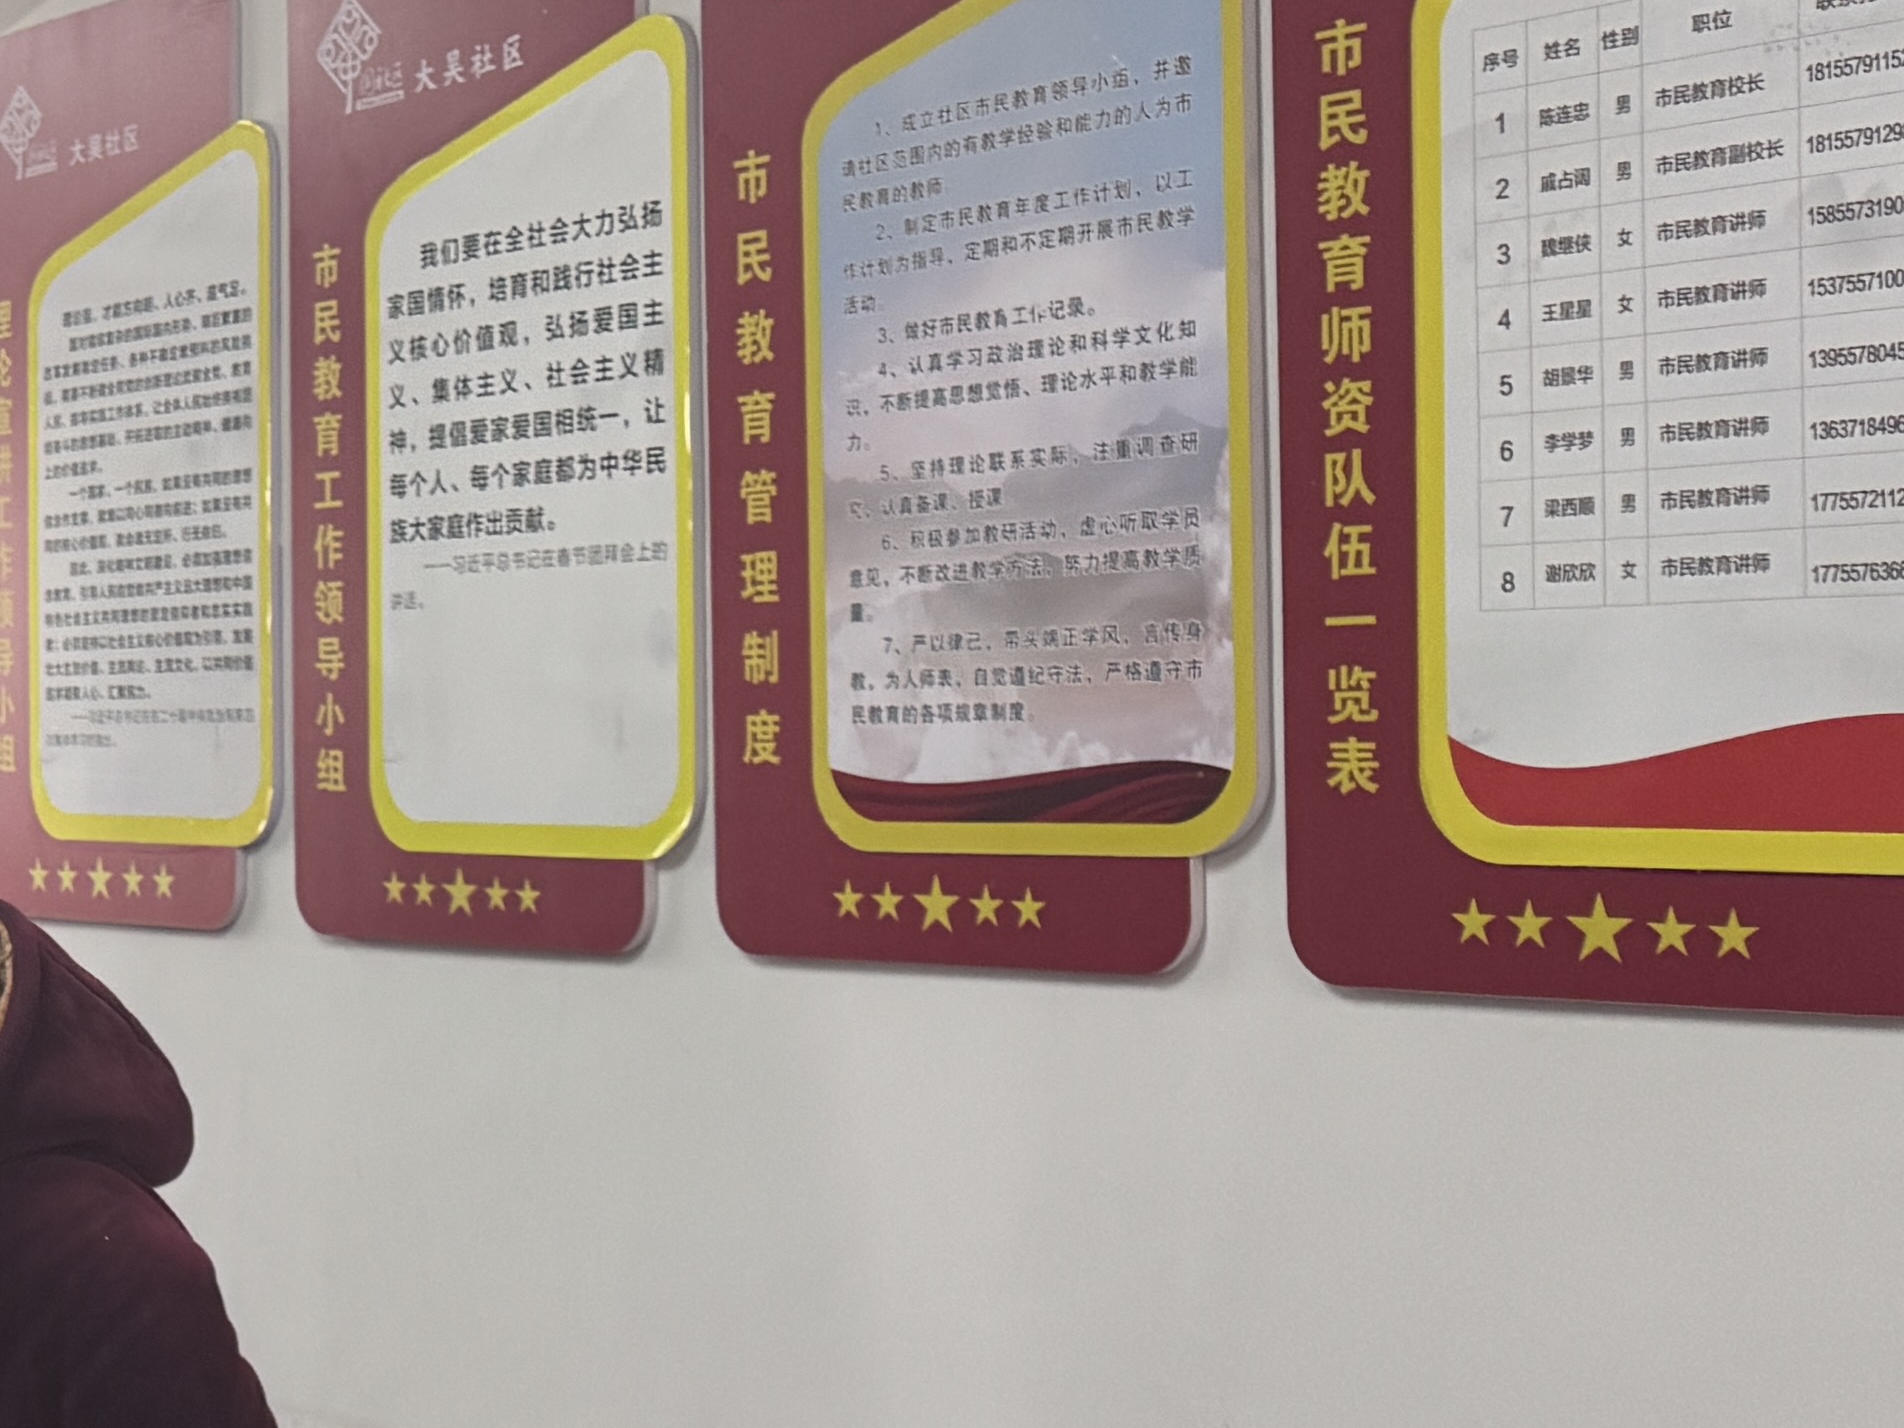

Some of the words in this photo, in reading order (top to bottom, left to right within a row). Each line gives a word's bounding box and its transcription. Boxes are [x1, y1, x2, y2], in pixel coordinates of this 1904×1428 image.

[414, 34, 525, 93] 大吴社区
[1482, 48, 1519, 72] 序号
[1544, 37, 1581, 62] 姓名
[1601, 25, 1640, 52] 性别
[1692, 9, 1732, 34] 职位
[1495, 112, 1506, 133] 1
[1616, 94, 1631, 115] 男
[1655, 72, 1765, 108] 市民教育校长
[1806, 47, 1904, 83] 1815579115
[1495, 178, 1510, 199] 2
[1616, 161, 1633, 182] 男
[1656, 138, 1784, 176] 市民教育副校长
[420, 200, 662, 269] 我们要在全社会大力弘扬
[1497, 244, 1511, 266] 3
[1617, 227, 1633, 248] 女
[1656, 208, 1767, 243] 市民教育讲师
[1497, 308, 1511, 329] 4
[1617, 294, 1634, 315] 女
[1657, 278, 1768, 310] 市民教育讲师
[1499, 376, 1513, 397] 5
[1619, 360, 1634, 380] 男
[1658, 346, 1769, 378] 市民教育讲师
[1314, 19, 1379, 796] 市民教育师资队伍一览表
[733, 149, 781, 767] 市民教育管理制度
[1500, 440, 1514, 462] 6
[1620, 426, 1636, 447] 男
[1659, 415, 1769, 445] 市民教育讲师
[390, 446, 667, 499] 每个人、每个家庭都为中华民
[312, 243, 347, 792] 市民教育工作领导小组
[1500, 506, 1514, 527] 7
[1621, 493, 1636, 514] 男
[1660, 484, 1770, 512] 市民教育讲师
[1501, 571, 1515, 593] 8
[1621, 560, 1637, 580] 女
[1661, 552, 1770, 579] 市民教育讲师
